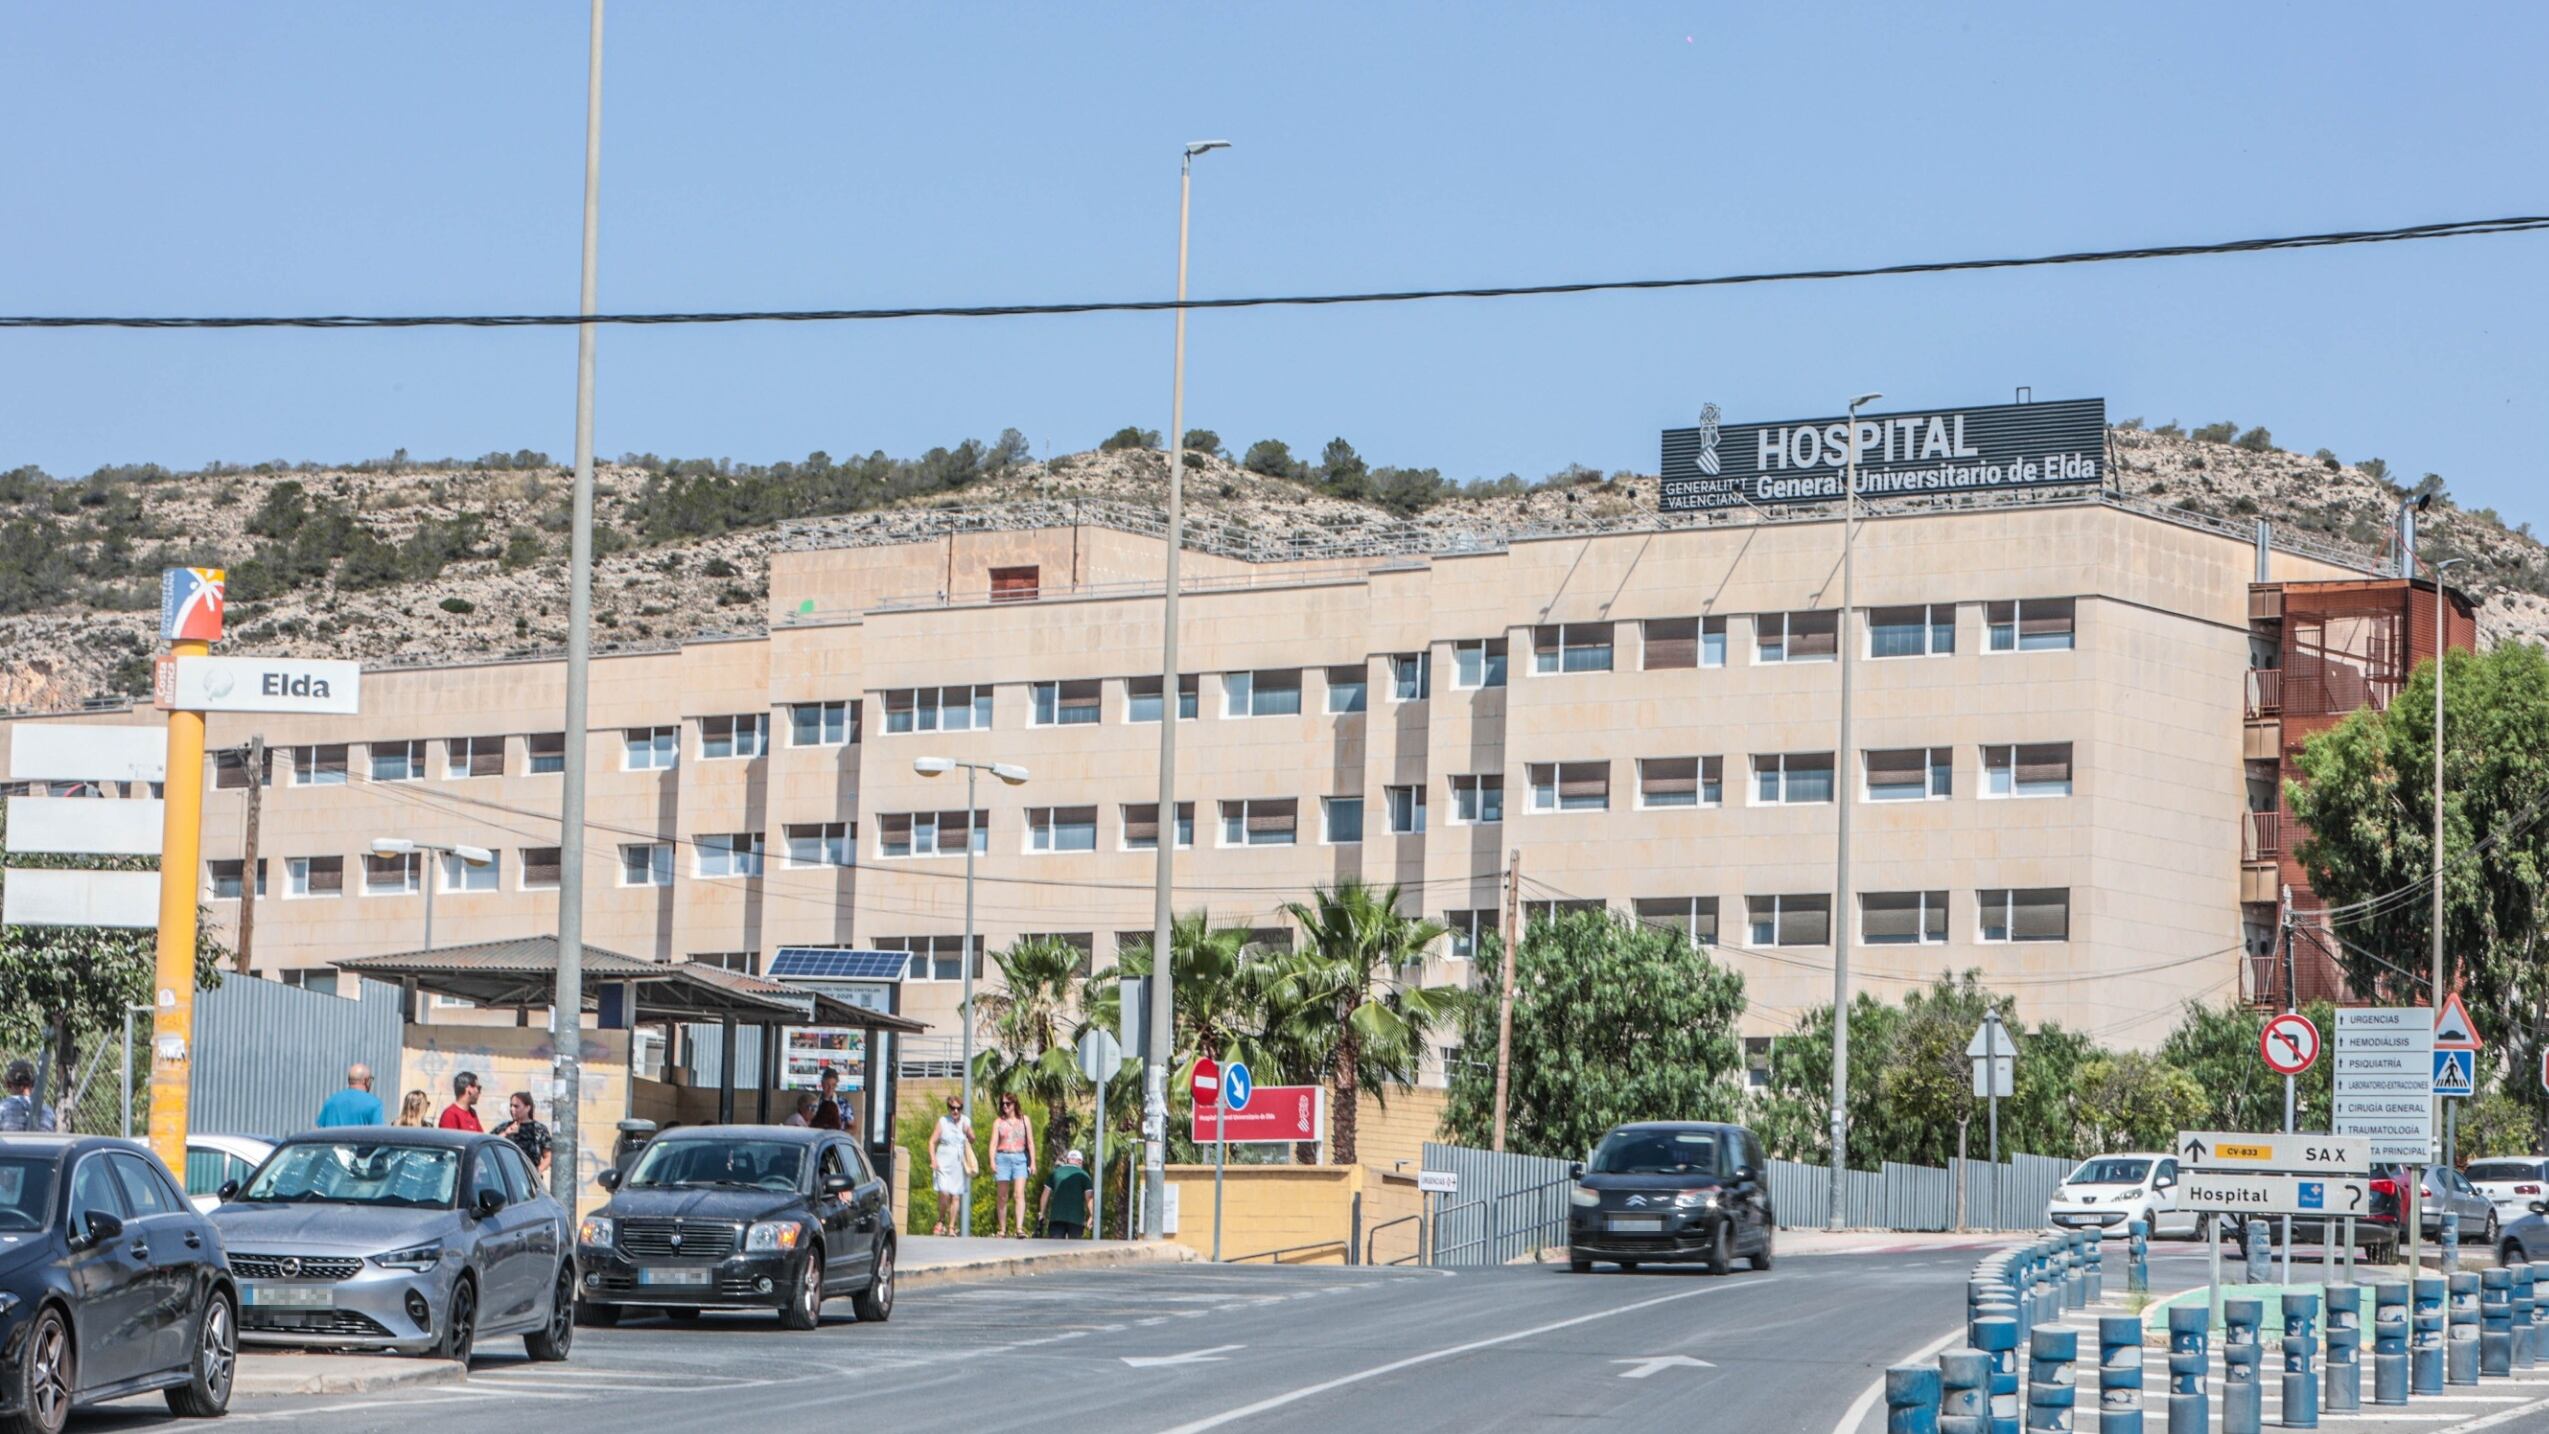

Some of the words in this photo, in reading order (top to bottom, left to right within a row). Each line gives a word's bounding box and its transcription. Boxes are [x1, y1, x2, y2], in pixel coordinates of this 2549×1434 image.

[1757, 414, 1979, 471] HOSPITAL
[1756, 468, 1845, 500] General
[1853, 459, 2002, 493] Universitario
[2008, 455, 2038, 483] de
[2043, 452, 2096, 481] Elda
[1665, 478, 1748, 496] GENERALITT
[156, 661, 167, 697] Costa
[165, 661, 175, 704] Blanca
[262, 672, 330, 698] Elda
[2350, 1015, 2400, 1025] URGENCIAS
[2349, 1057, 2402, 1069] PSIQUIATRÍA
[2348, 1102, 2383, 1113] CIRUGÍA
[2385, 1103, 2425, 1113] GENERAL
[2348, 1123, 2420, 1135] TRAUMATOLOGÍA
[2227, 1147, 2258, 1156] CV-833
[2306, 1147, 2346, 1162] SAX
[2382, 1146, 2427, 1156] PRINCIPAL
[2190, 1186, 2268, 1204] Hospital
